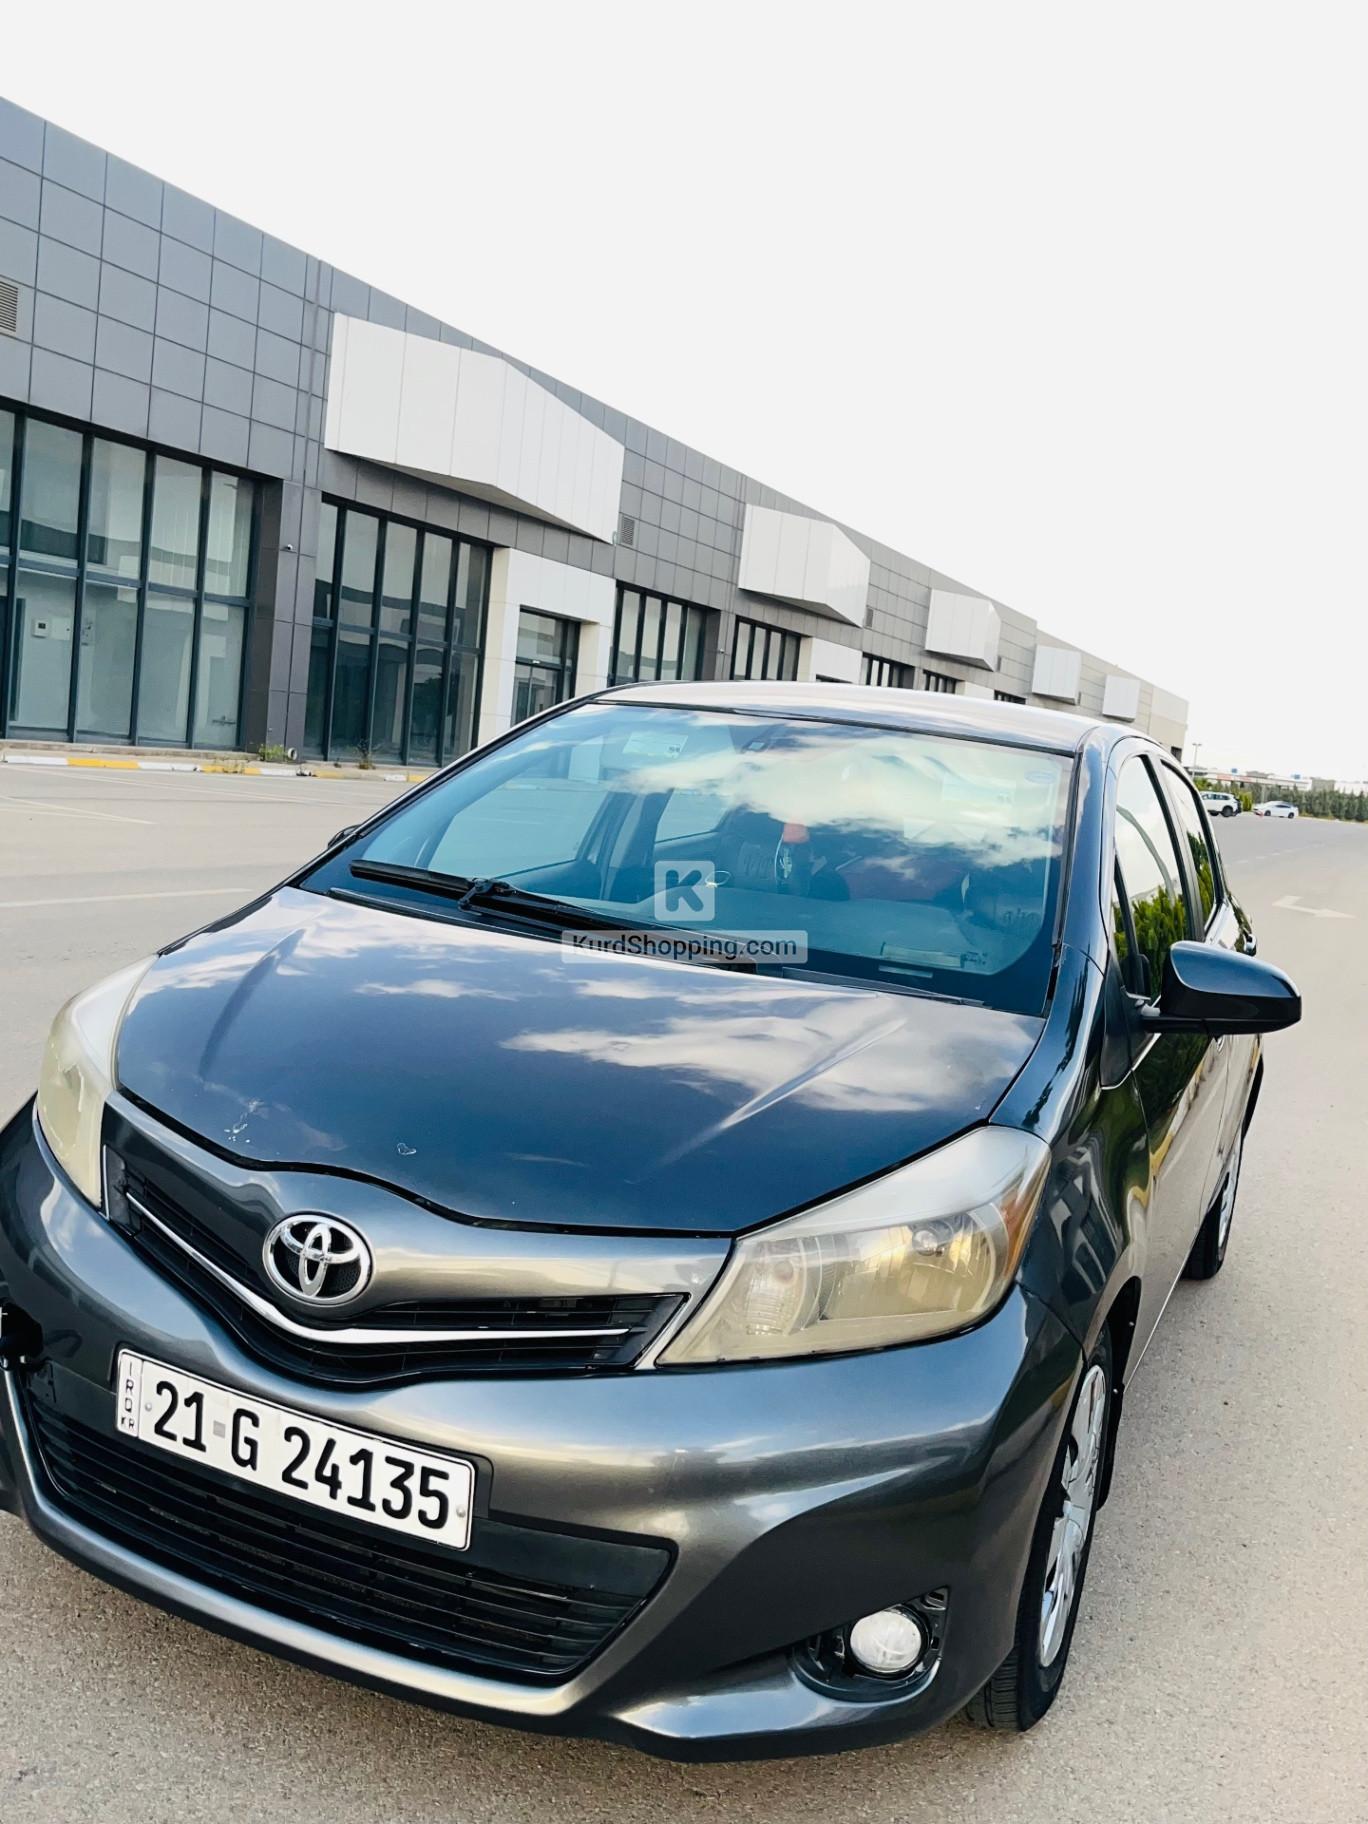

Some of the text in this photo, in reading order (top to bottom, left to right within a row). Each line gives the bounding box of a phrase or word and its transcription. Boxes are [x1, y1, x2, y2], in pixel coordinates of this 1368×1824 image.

[124, 1361, 135, 1413] IRQ
[154, 1380, 449, 1530] 21 G 24135
